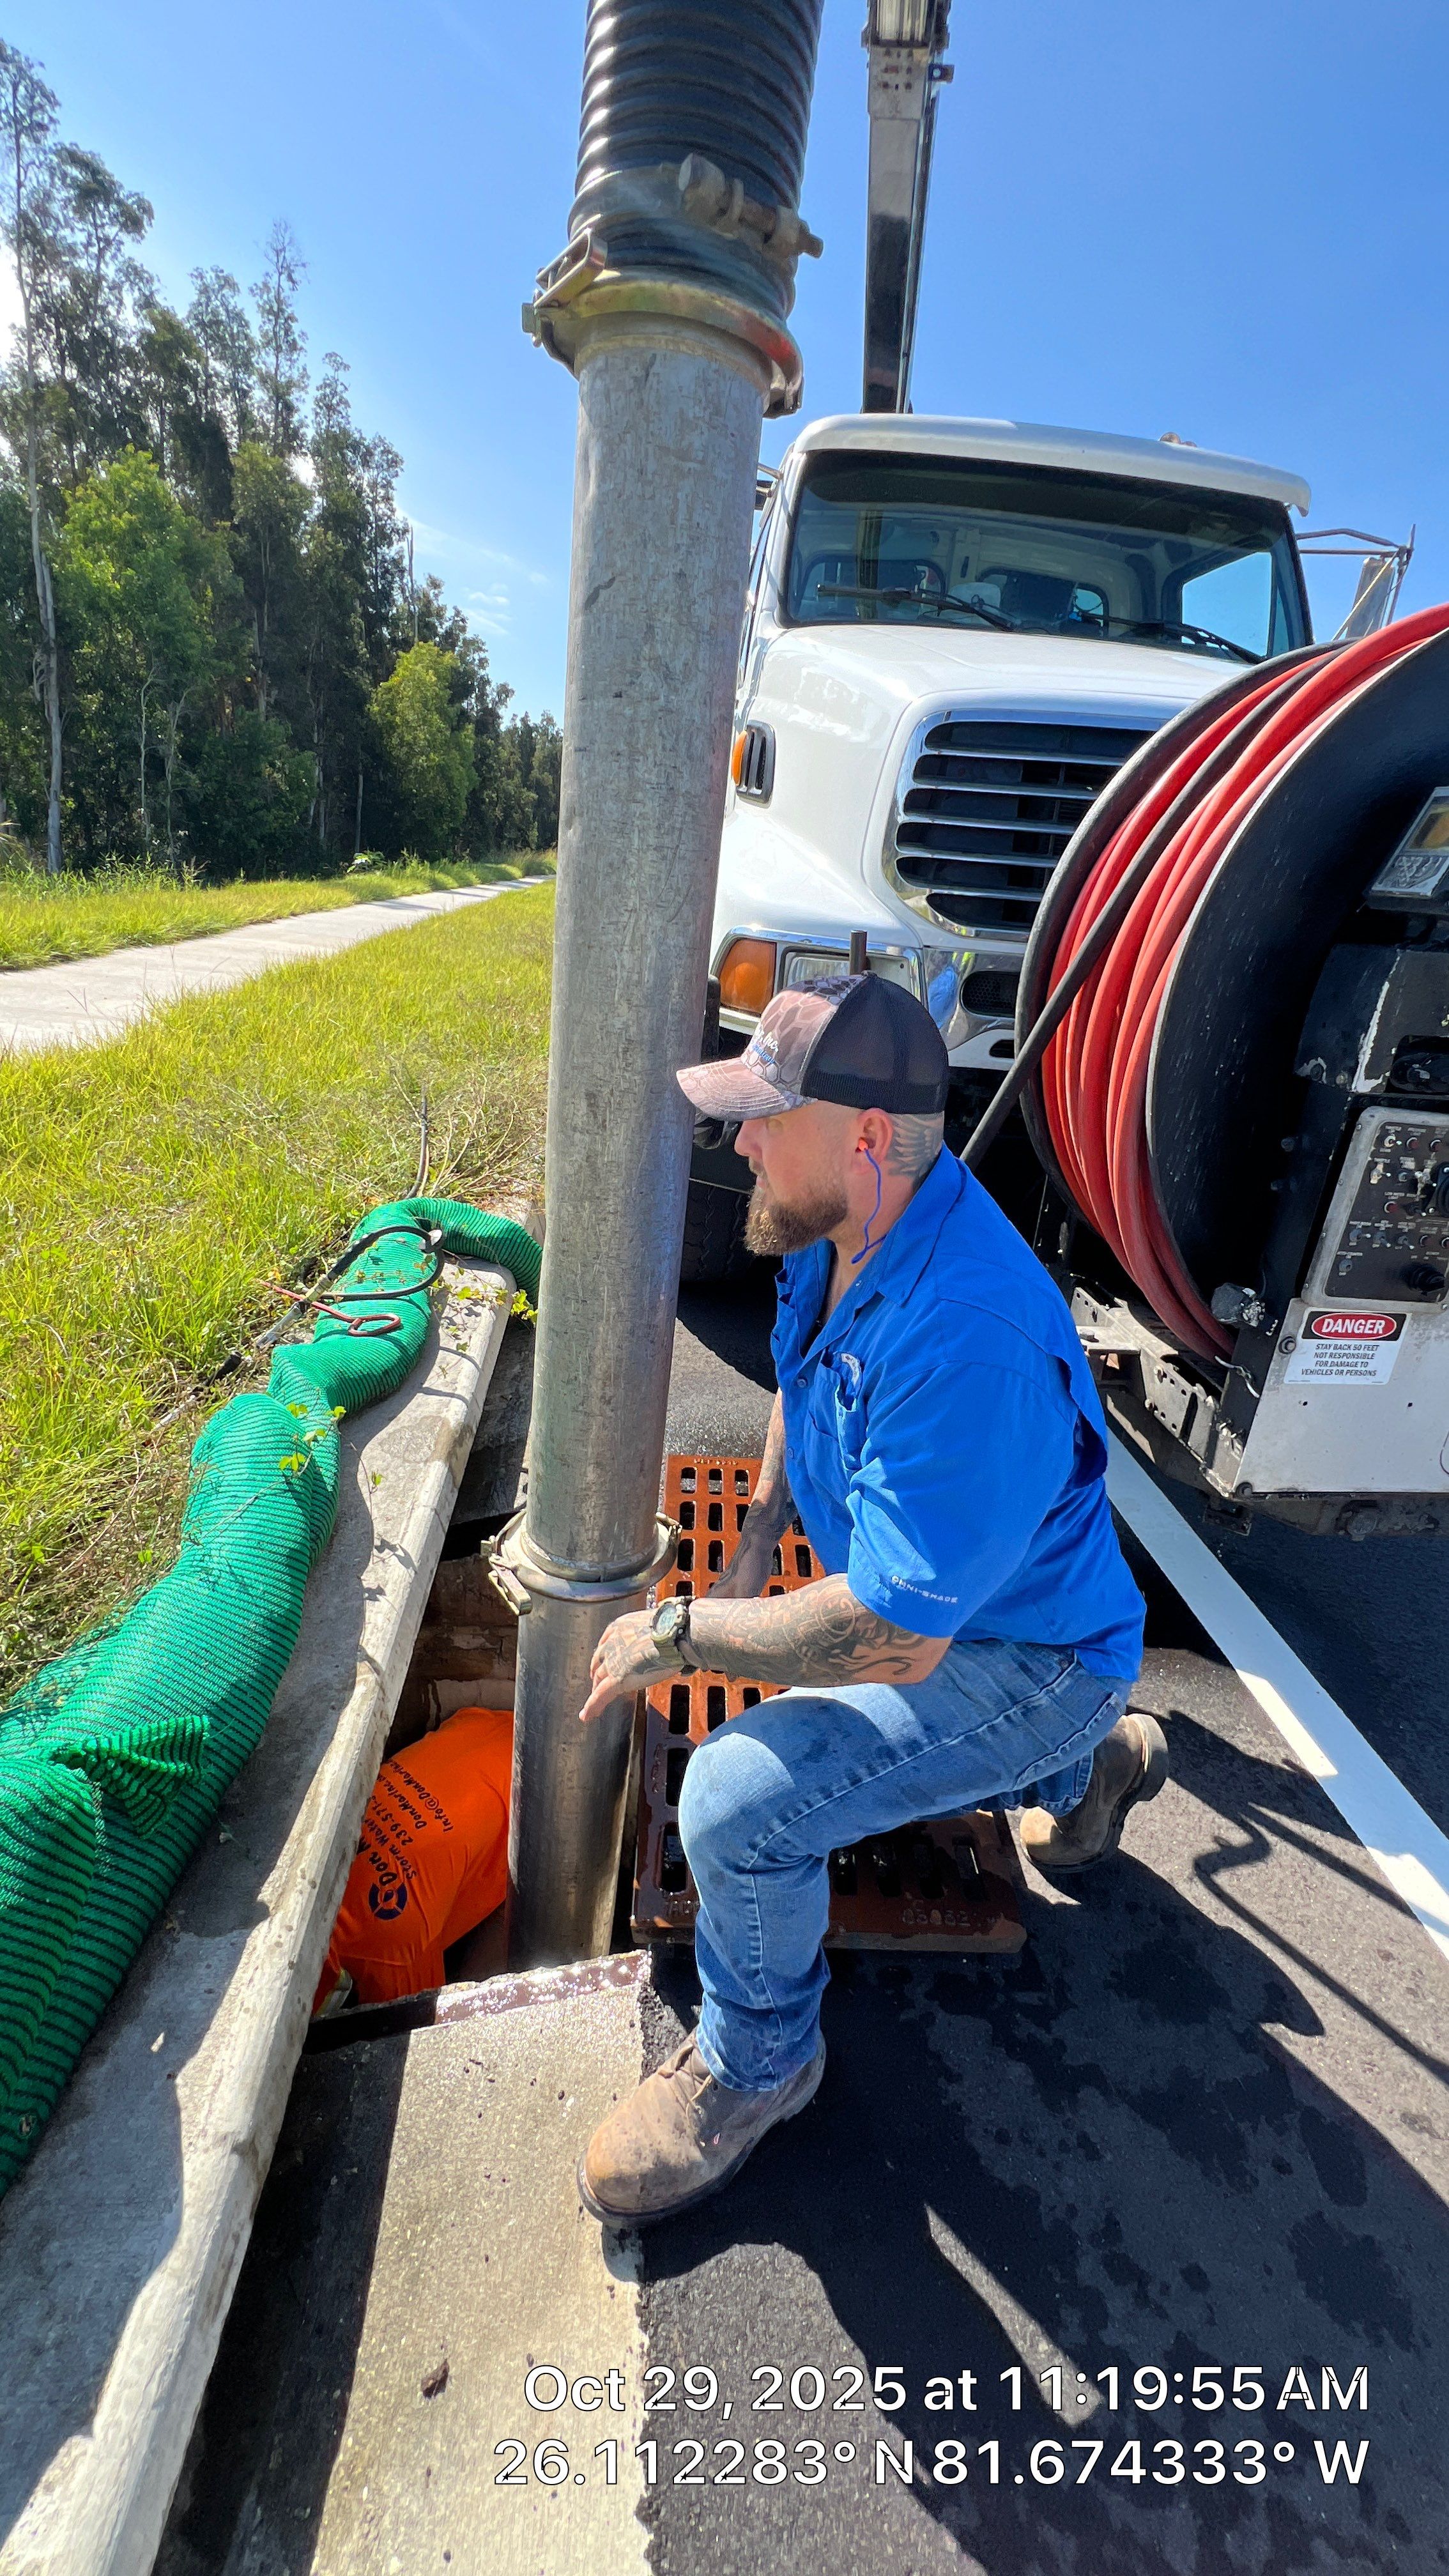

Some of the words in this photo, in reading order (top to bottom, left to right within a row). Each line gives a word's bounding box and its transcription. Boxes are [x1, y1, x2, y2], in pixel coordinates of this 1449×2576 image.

[1321, 1318, 1386, 1335] DANGER
[368, 1851, 397, 1886] Don
[388, 1844, 417, 1880] Storm
